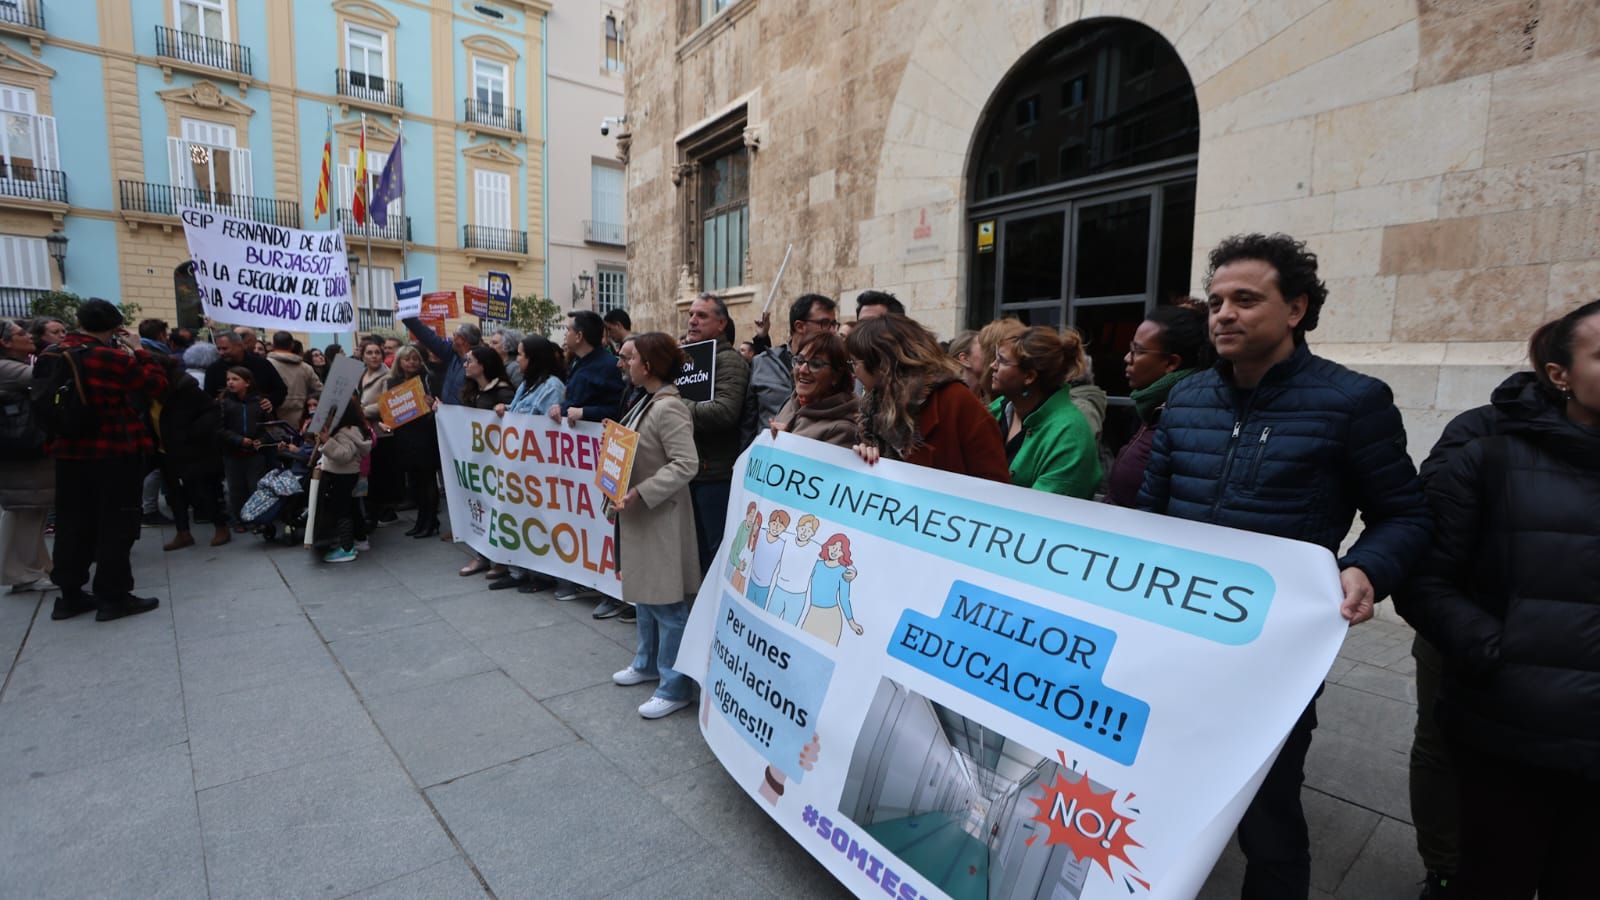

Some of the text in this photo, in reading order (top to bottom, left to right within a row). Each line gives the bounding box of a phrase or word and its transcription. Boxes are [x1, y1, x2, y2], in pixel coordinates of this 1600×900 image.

[182, 209, 214, 229] CEIP
[222, 219, 291, 249] FERNANDO
[299, 233, 314, 252] DE
[246, 247, 334, 275] BURJASSOT
[213, 262, 230, 281] LA
[238, 268, 298, 295] EJECUCIÓN
[301, 277, 320, 297] DEL
[228, 290, 301, 320] SEGURIDAD
[305, 301, 318, 321] EN
[321, 302, 331, 323] EL
[675, 369, 709, 386] UCACIÓN
[683, 362, 695, 373] ON
[453, 458, 596, 520] NECESSITA
[489, 508, 621, 581] ESCOLA
[829, 482, 1255, 623] INFRAESTRUCTURES
[726, 608, 791, 670] Per unes
[951, 594, 1097, 669] MILLOR
[714, 679, 774, 748] dignes!!!
[900, 623, 1128, 742] EDUCACIÓ!!!
[1048, 791, 1121, 849] NO!
[802, 804, 929, 900] #SOMIES
